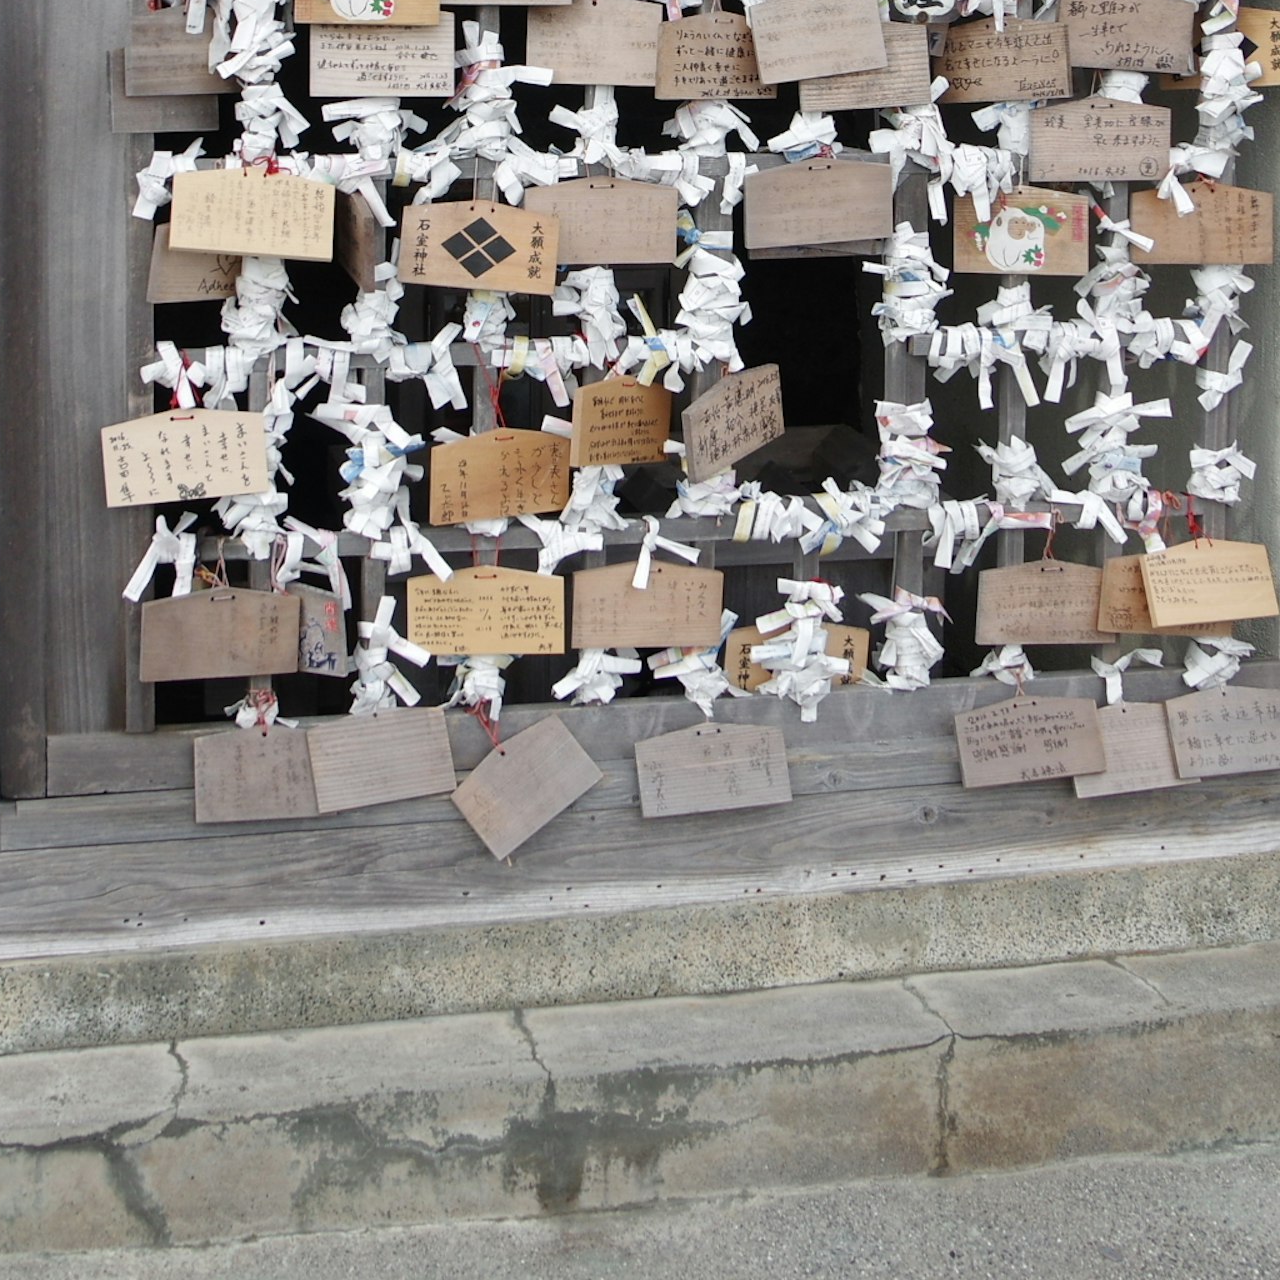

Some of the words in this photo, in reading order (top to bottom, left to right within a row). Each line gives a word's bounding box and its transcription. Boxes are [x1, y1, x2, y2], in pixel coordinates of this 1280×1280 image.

[411, 219, 430, 277] 石室神社
[527, 221, 545, 280] 大願成就
